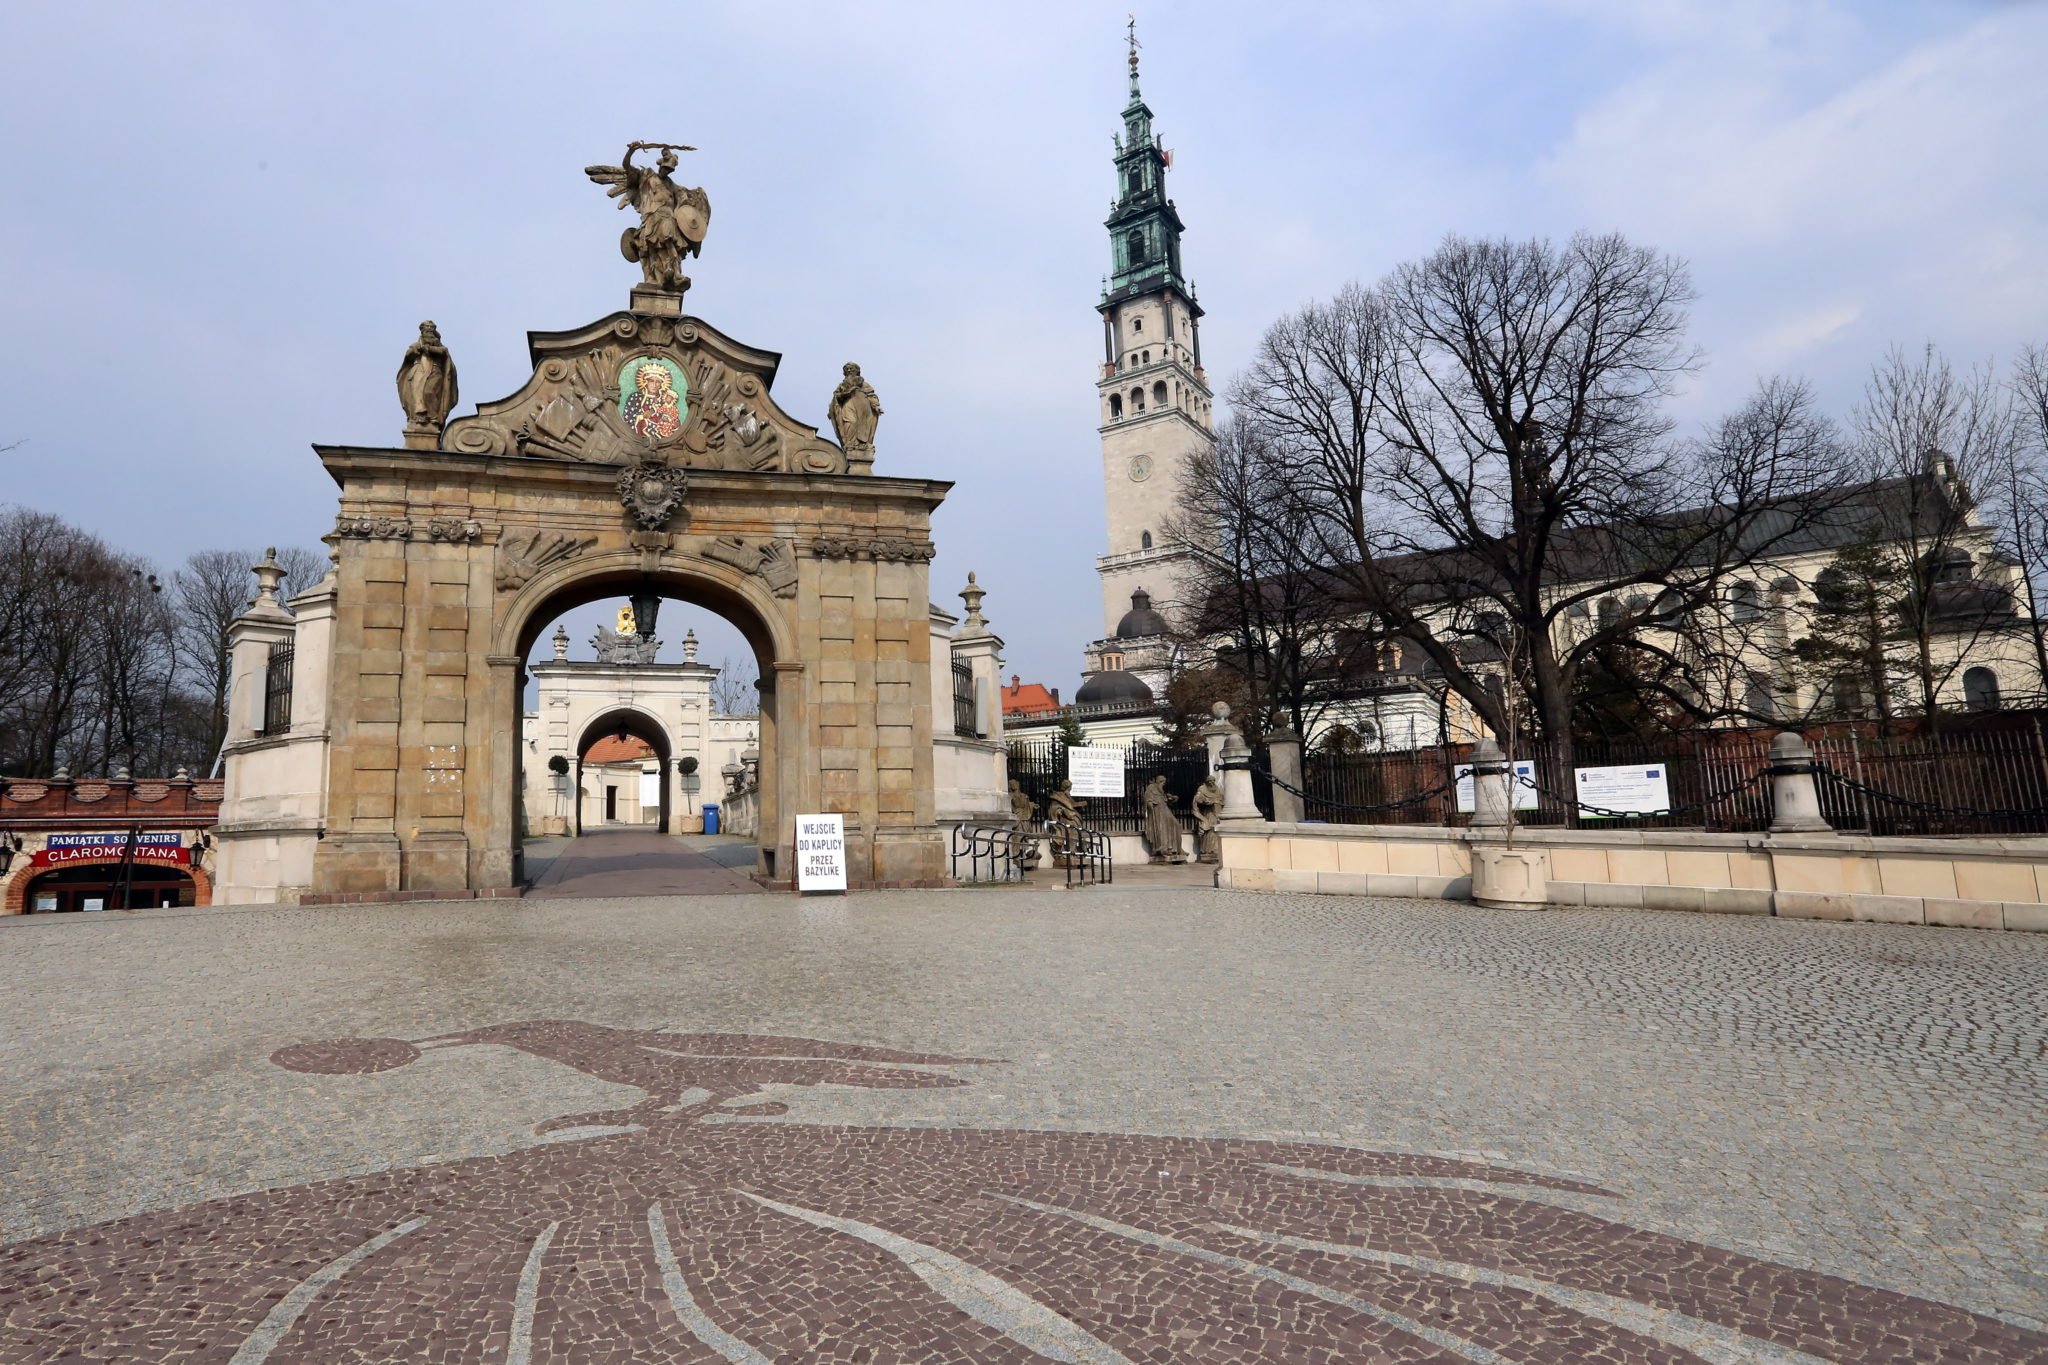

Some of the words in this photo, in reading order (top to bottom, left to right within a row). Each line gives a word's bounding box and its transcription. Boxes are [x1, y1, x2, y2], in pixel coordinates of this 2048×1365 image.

[803, 823, 836, 835] WEJŚCIE
[51, 835, 105, 846] PAMIĄTKI
[113, 834, 177, 844] SOVENIRS
[799, 840, 809, 850] DO
[811, 839, 842, 850] KAPLICY
[810, 855, 834, 865] PRZEZ
